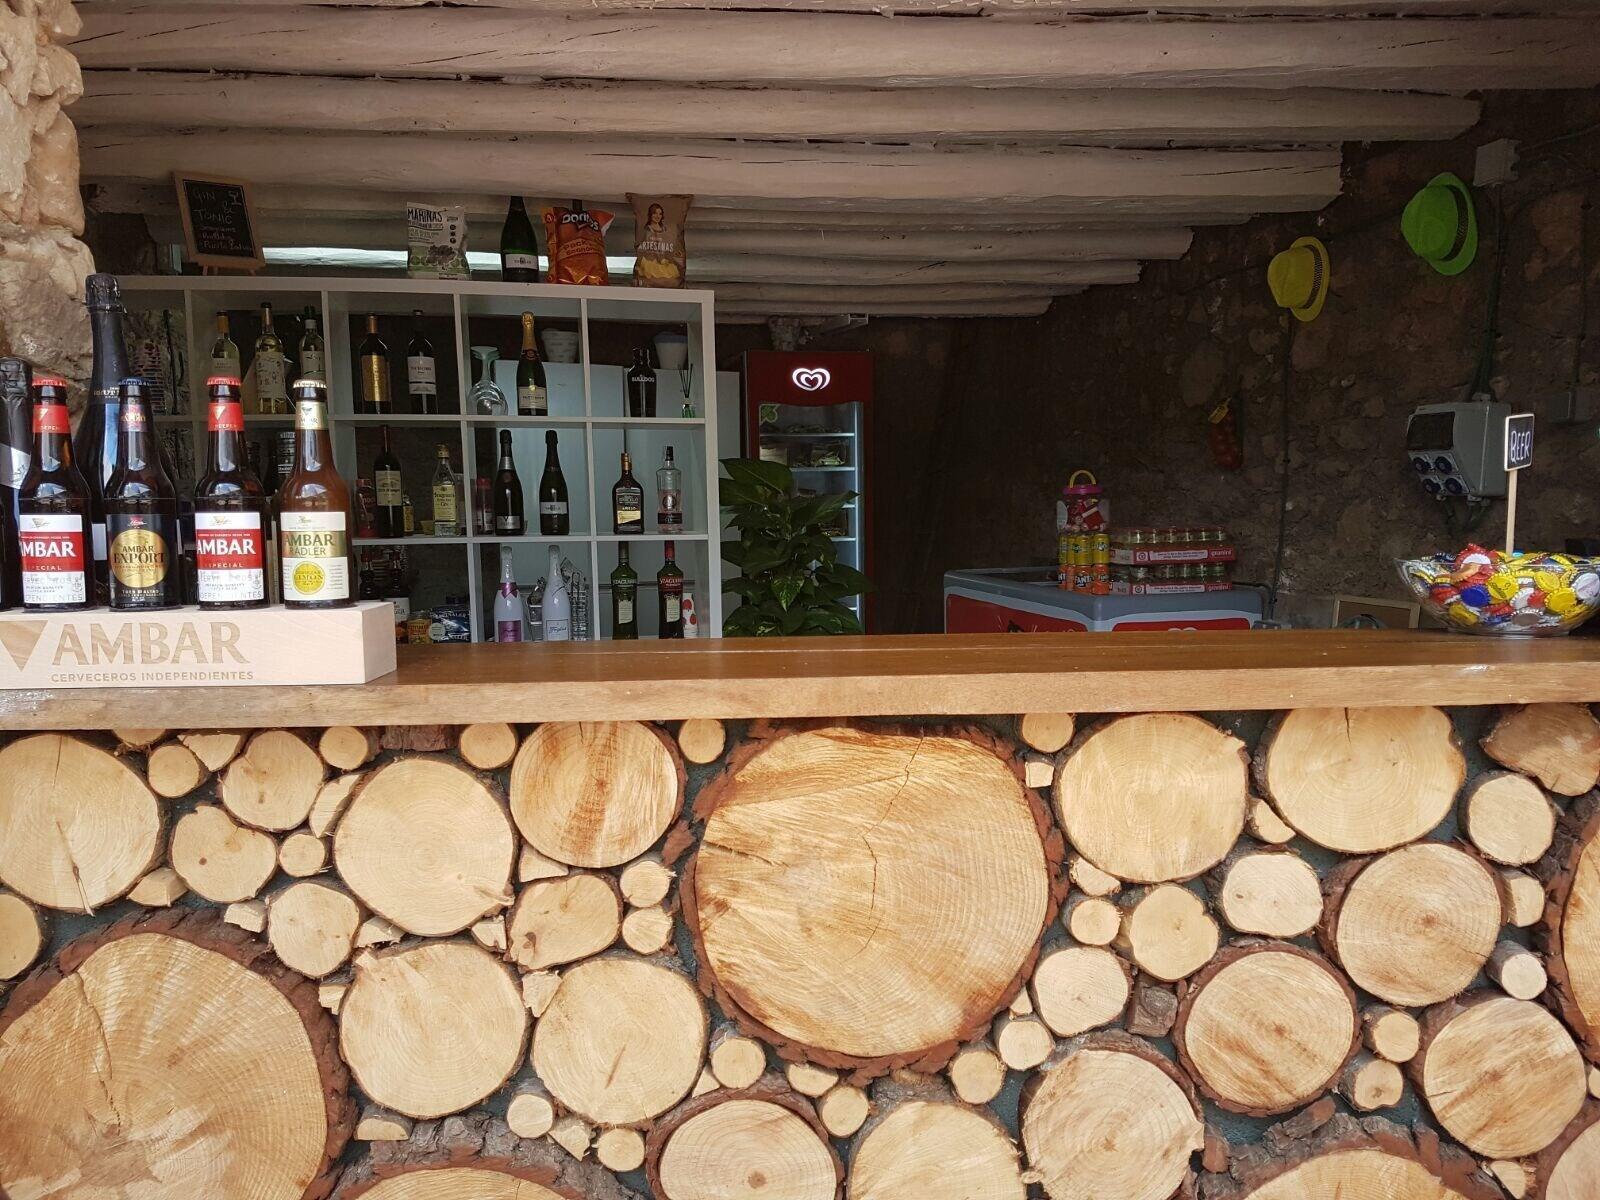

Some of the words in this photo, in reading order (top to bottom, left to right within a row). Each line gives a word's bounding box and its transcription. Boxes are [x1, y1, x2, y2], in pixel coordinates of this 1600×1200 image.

[1510, 430, 1531, 464] BEER
[197, 538, 257, 555] AMBAR
[286, 534, 335, 547] AMBAR
[122, 545, 155, 553] AMBAR
[290, 547, 327, 556] RADLER
[114, 552, 166, 564] EXPORT
[51, 621, 252, 667] AMBAR
[51, 672, 138, 684] CERVECEROS
[141, 671, 254, 682] INDEPENDIENTES
